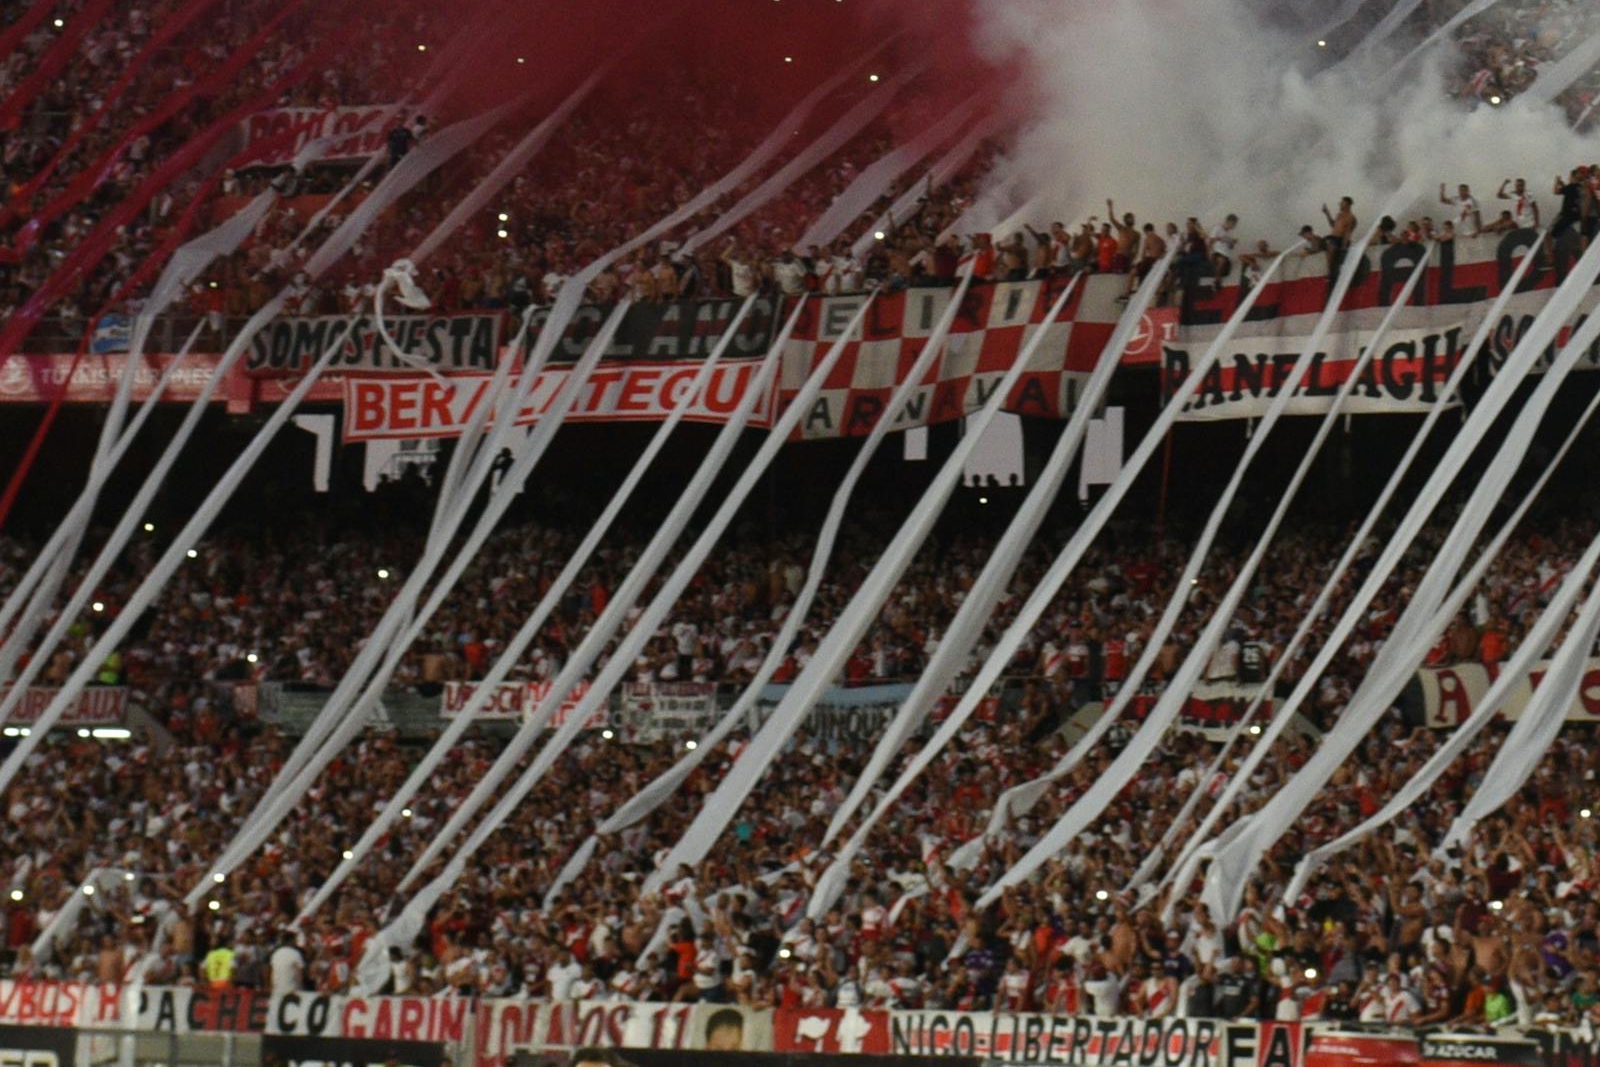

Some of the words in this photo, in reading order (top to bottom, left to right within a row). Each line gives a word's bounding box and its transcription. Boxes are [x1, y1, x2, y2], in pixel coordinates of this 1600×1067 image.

[248, 318, 371, 369] SOMOS
[373, 316, 495, 368] FIESTA
[1162, 327, 1463, 413] RANELAGH
[780, 376, 1088, 431] ARNAVAL
